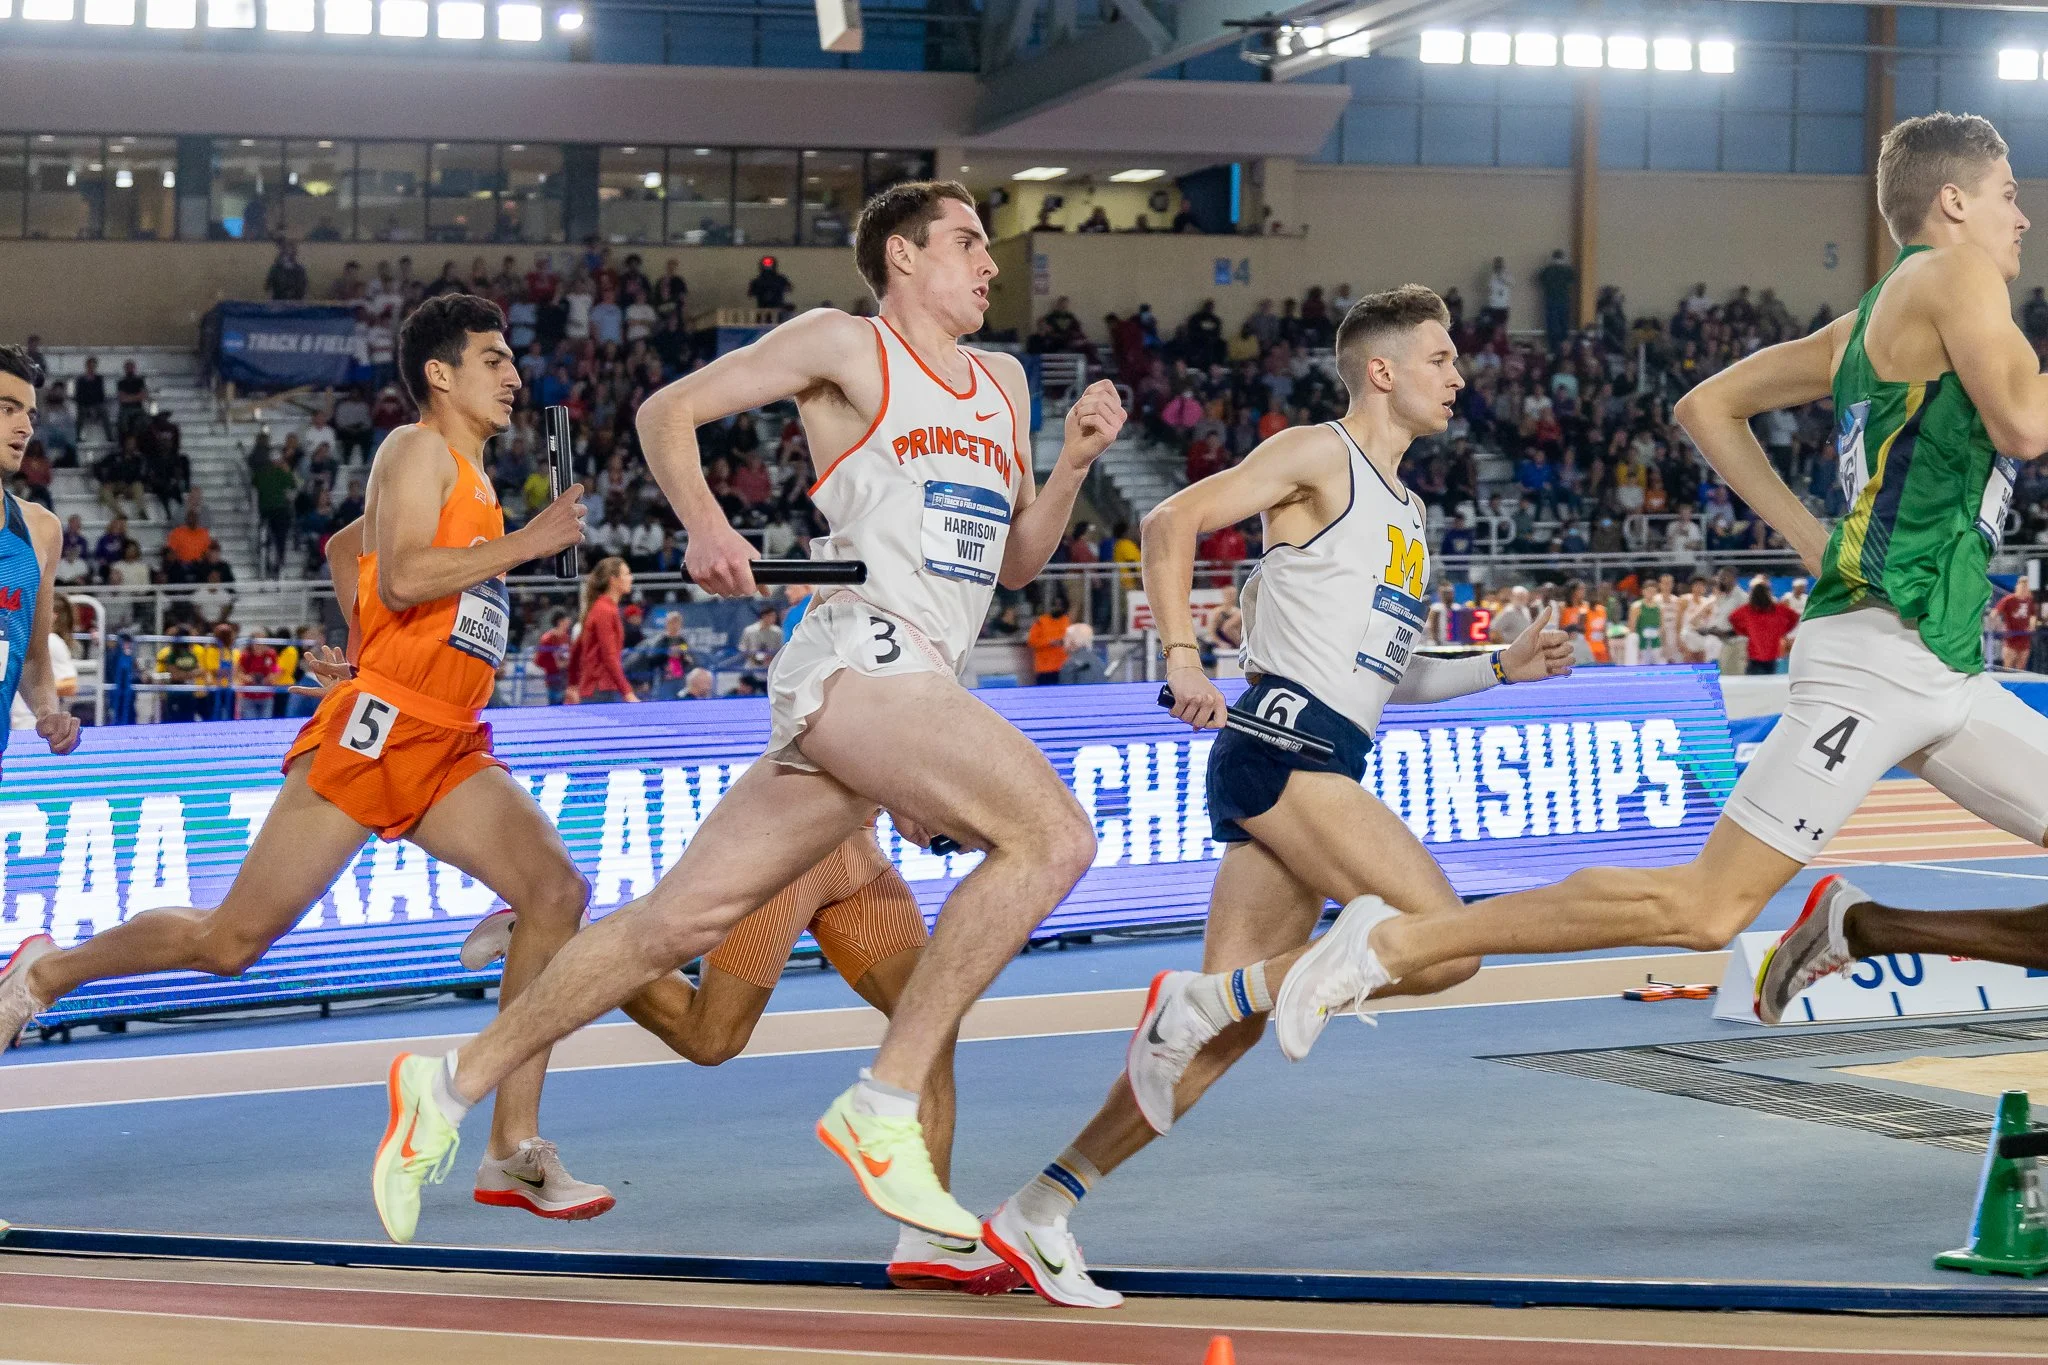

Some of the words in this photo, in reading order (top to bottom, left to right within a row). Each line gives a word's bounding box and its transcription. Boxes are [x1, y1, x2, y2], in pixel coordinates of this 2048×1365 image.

[248, 332, 298, 351] TRACK
[892, 426, 1011, 489] PRINCETON
[944, 516, 997, 541] HARRISON
[957, 538, 985, 563] WITT
[1384, 524, 1425, 600] M
[869, 616, 901, 664] 3
[1395, 626, 1413, 646] TOM
[1471, 610, 1490, 641] 2
[350, 698, 390, 750] 5
[1264, 693, 1297, 729] 6
[1813, 716, 1859, 771] 4
[1073, 718, 1688, 868] CHONSHIPS
